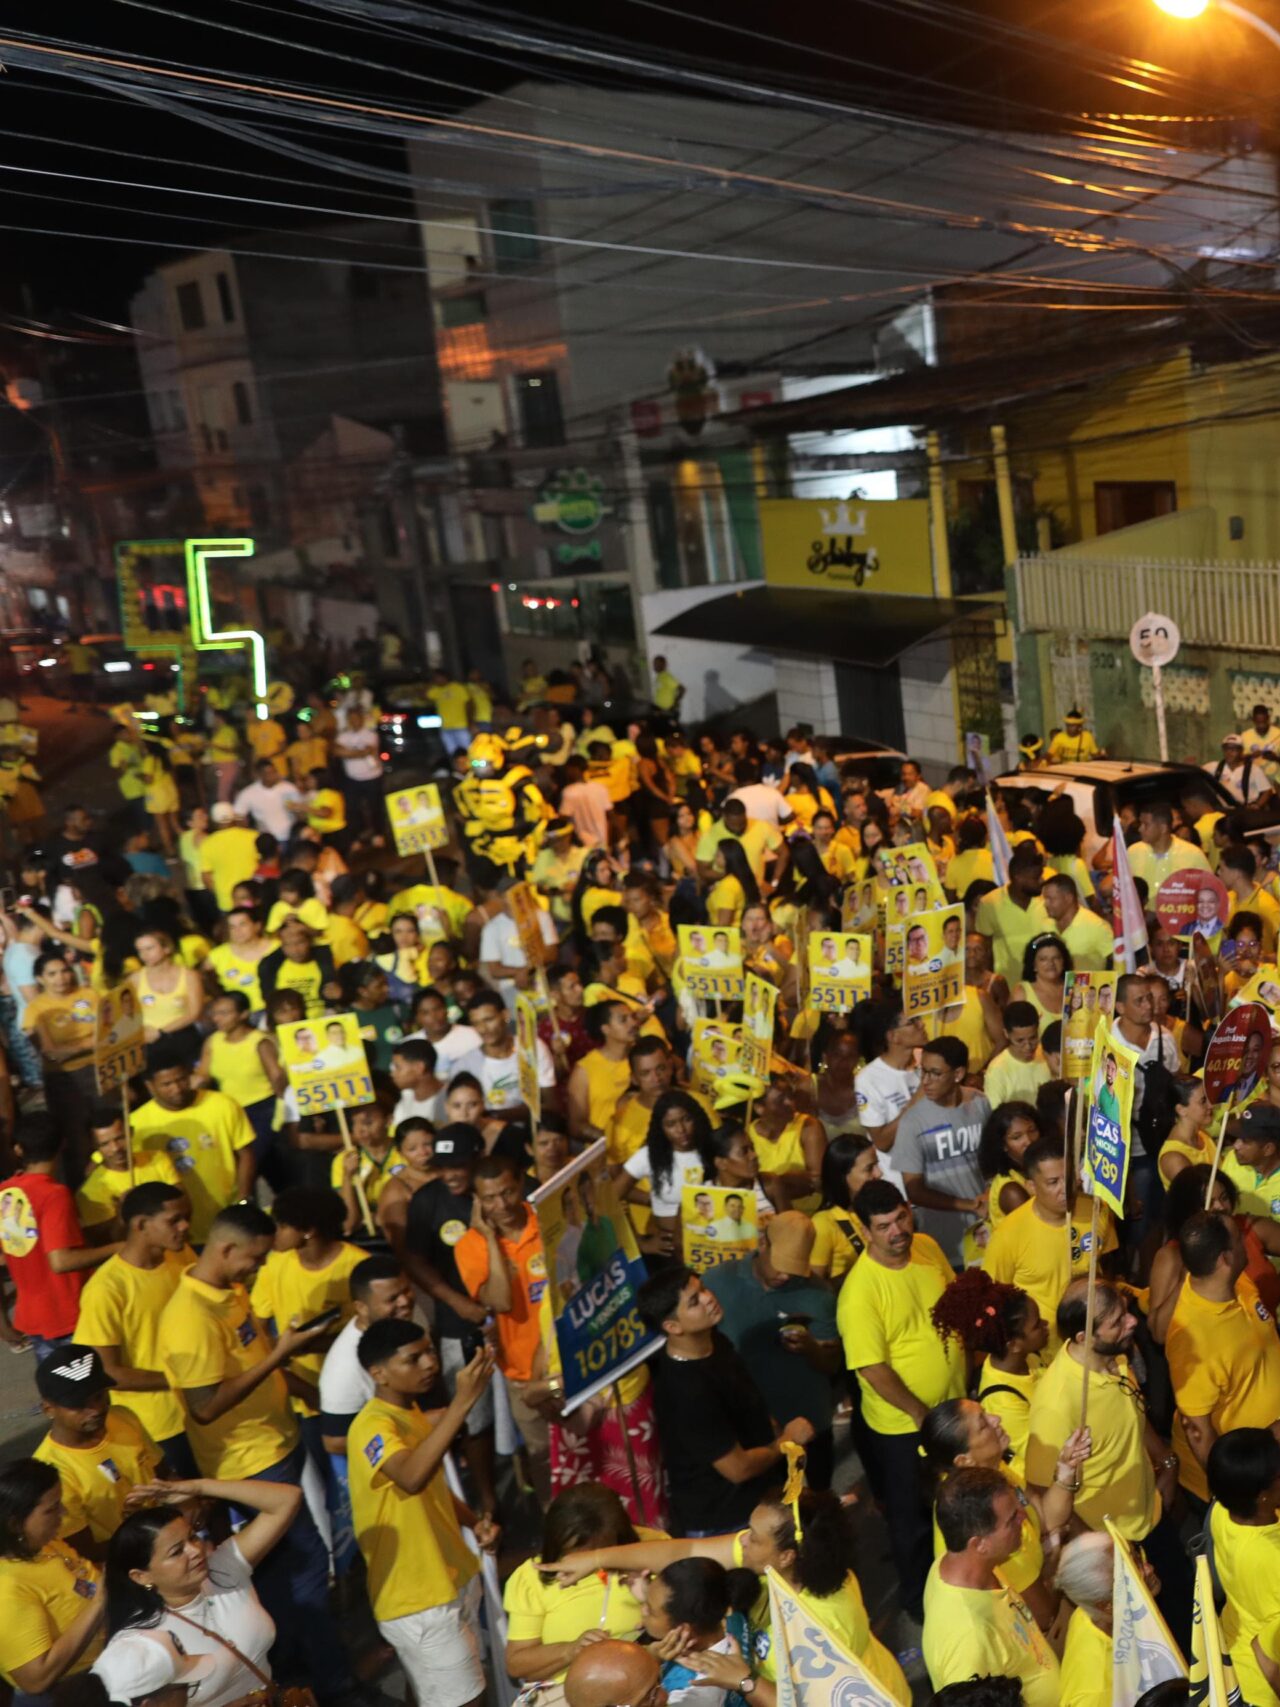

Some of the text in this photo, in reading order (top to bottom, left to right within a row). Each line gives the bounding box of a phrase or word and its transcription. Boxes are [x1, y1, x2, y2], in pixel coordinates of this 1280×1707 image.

[686, 976, 745, 993] 55111
[910, 980, 959, 1010] 55111
[296, 1077, 372, 1106] 55111
[935, 1123, 982, 1160] FLOW
[569, 1260, 626, 1329] LUCAS
